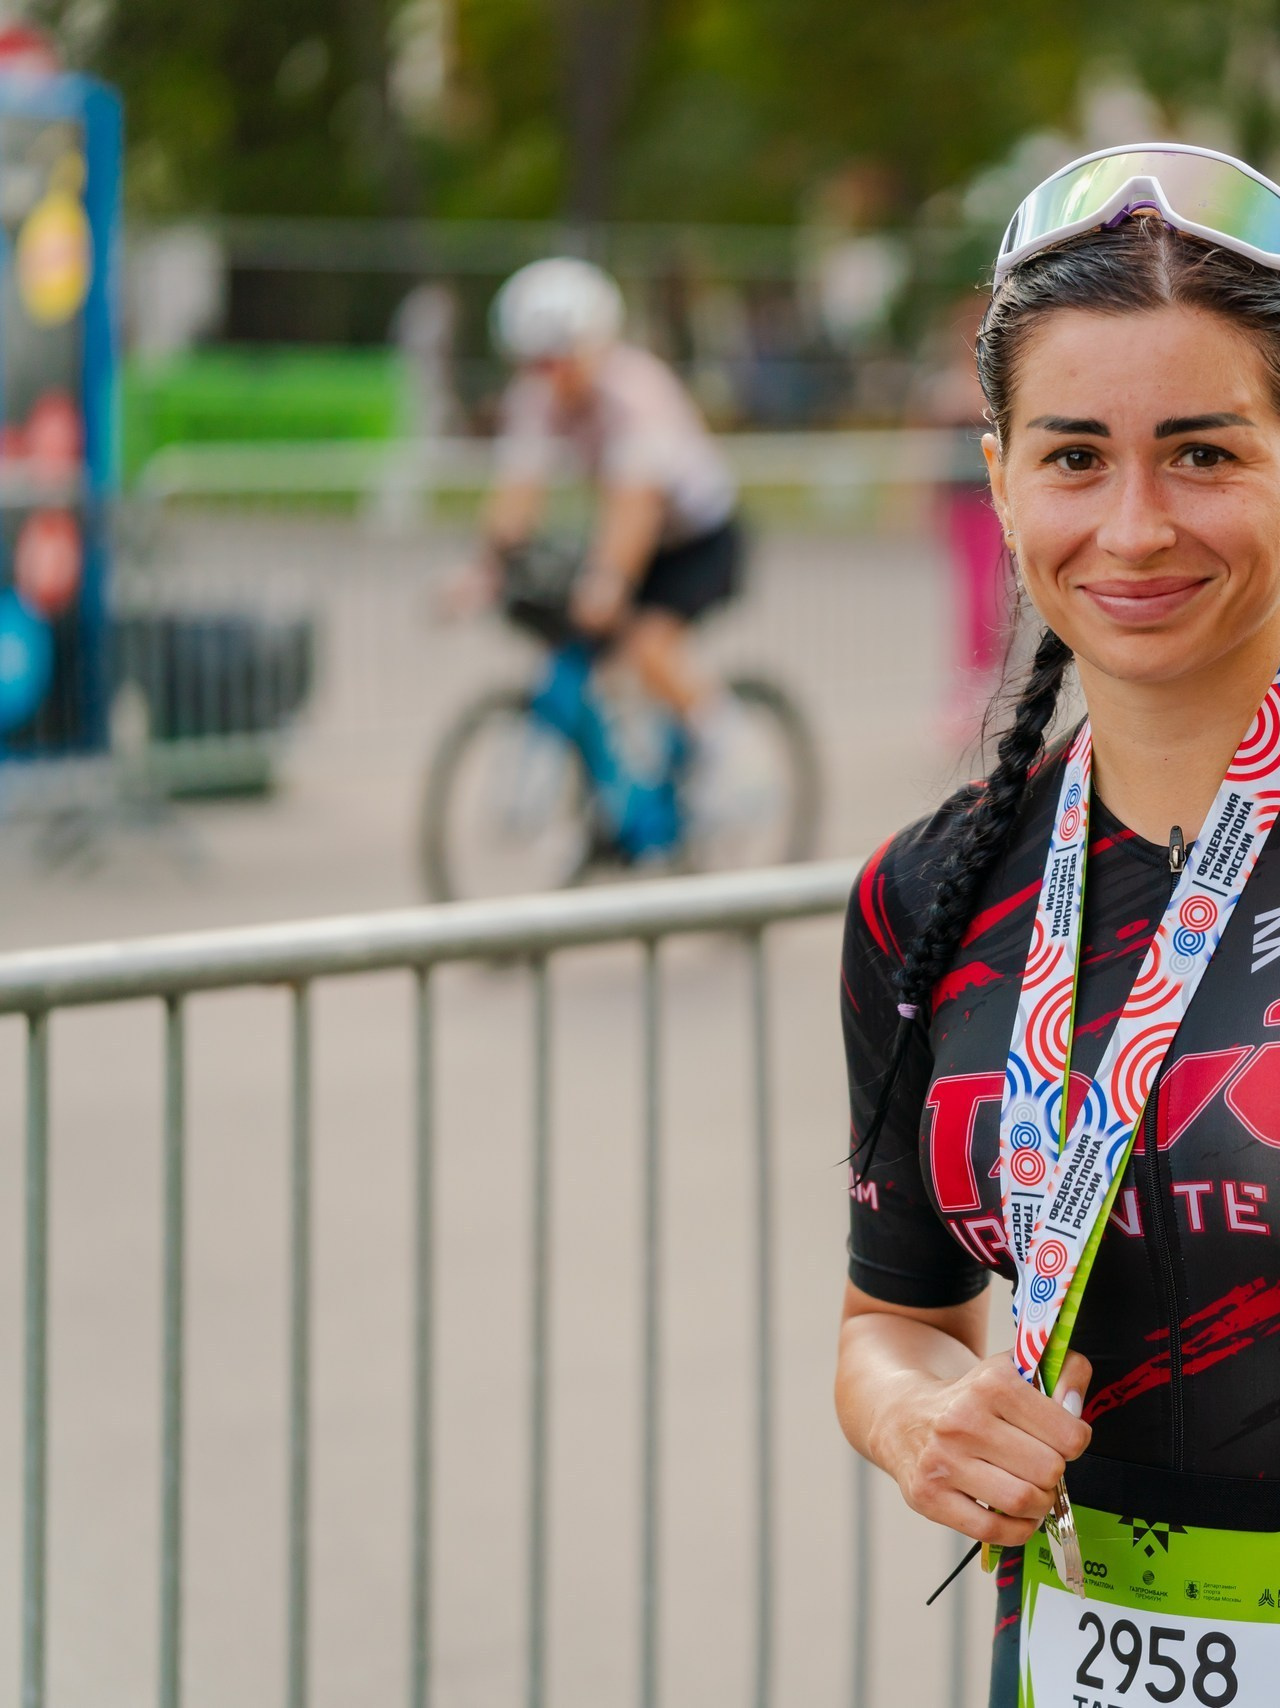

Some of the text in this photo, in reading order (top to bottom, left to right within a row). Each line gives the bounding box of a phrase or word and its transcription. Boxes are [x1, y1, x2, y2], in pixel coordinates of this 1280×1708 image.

[1196, 792, 1241, 877] ФЕДЕРАЦИЯ
[1209, 800, 1254, 881] ТРИАТЛОНА
[1222, 833, 1255, 887] РОССИИ
[1045, 858, 1060, 911] РОССИИ
[1051, 856, 1069, 938] ТРИАТЛОНА
[1061, 853, 1077, 937] ФЕДЕРАЦИЯ
[1049, 1133, 1091, 1221] ФЕДЕРАЦИЯ
[1060, 1139, 1103, 1223] ТРИАТЛОНА
[1072, 1172, 1103, 1230] РОССИИ
[947, 1186, 1144, 1264] IRN
[1011, 1202, 1024, 1262] РОССИИ
[1129, 1586, 1168, 1597] ГАЗПРОМБАНК
[1135, 1592, 1161, 1602] ПРЕМИУМ
[1076, 1611, 1238, 1708] 2958
